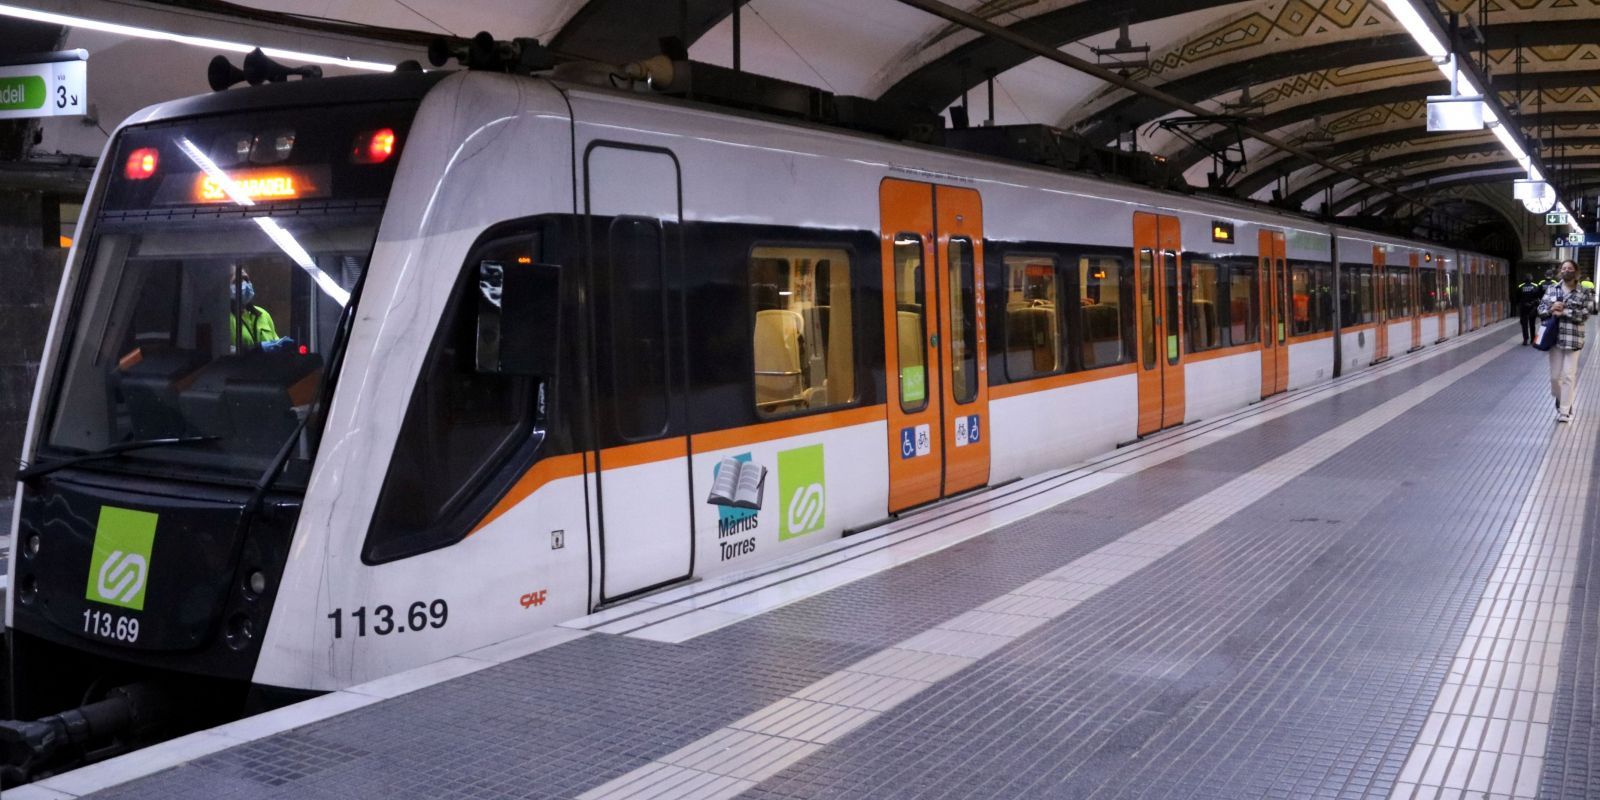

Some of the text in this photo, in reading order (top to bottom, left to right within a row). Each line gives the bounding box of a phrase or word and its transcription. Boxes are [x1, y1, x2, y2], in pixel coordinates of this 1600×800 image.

[57, 85, 67, 109] 3
[231, 177, 296, 197] ABADELL
[718, 512, 758, 539] Màrius
[720, 537, 756, 562] Torres
[83, 608, 139, 643] 113.69
[327, 599, 448, 639] 113.69
